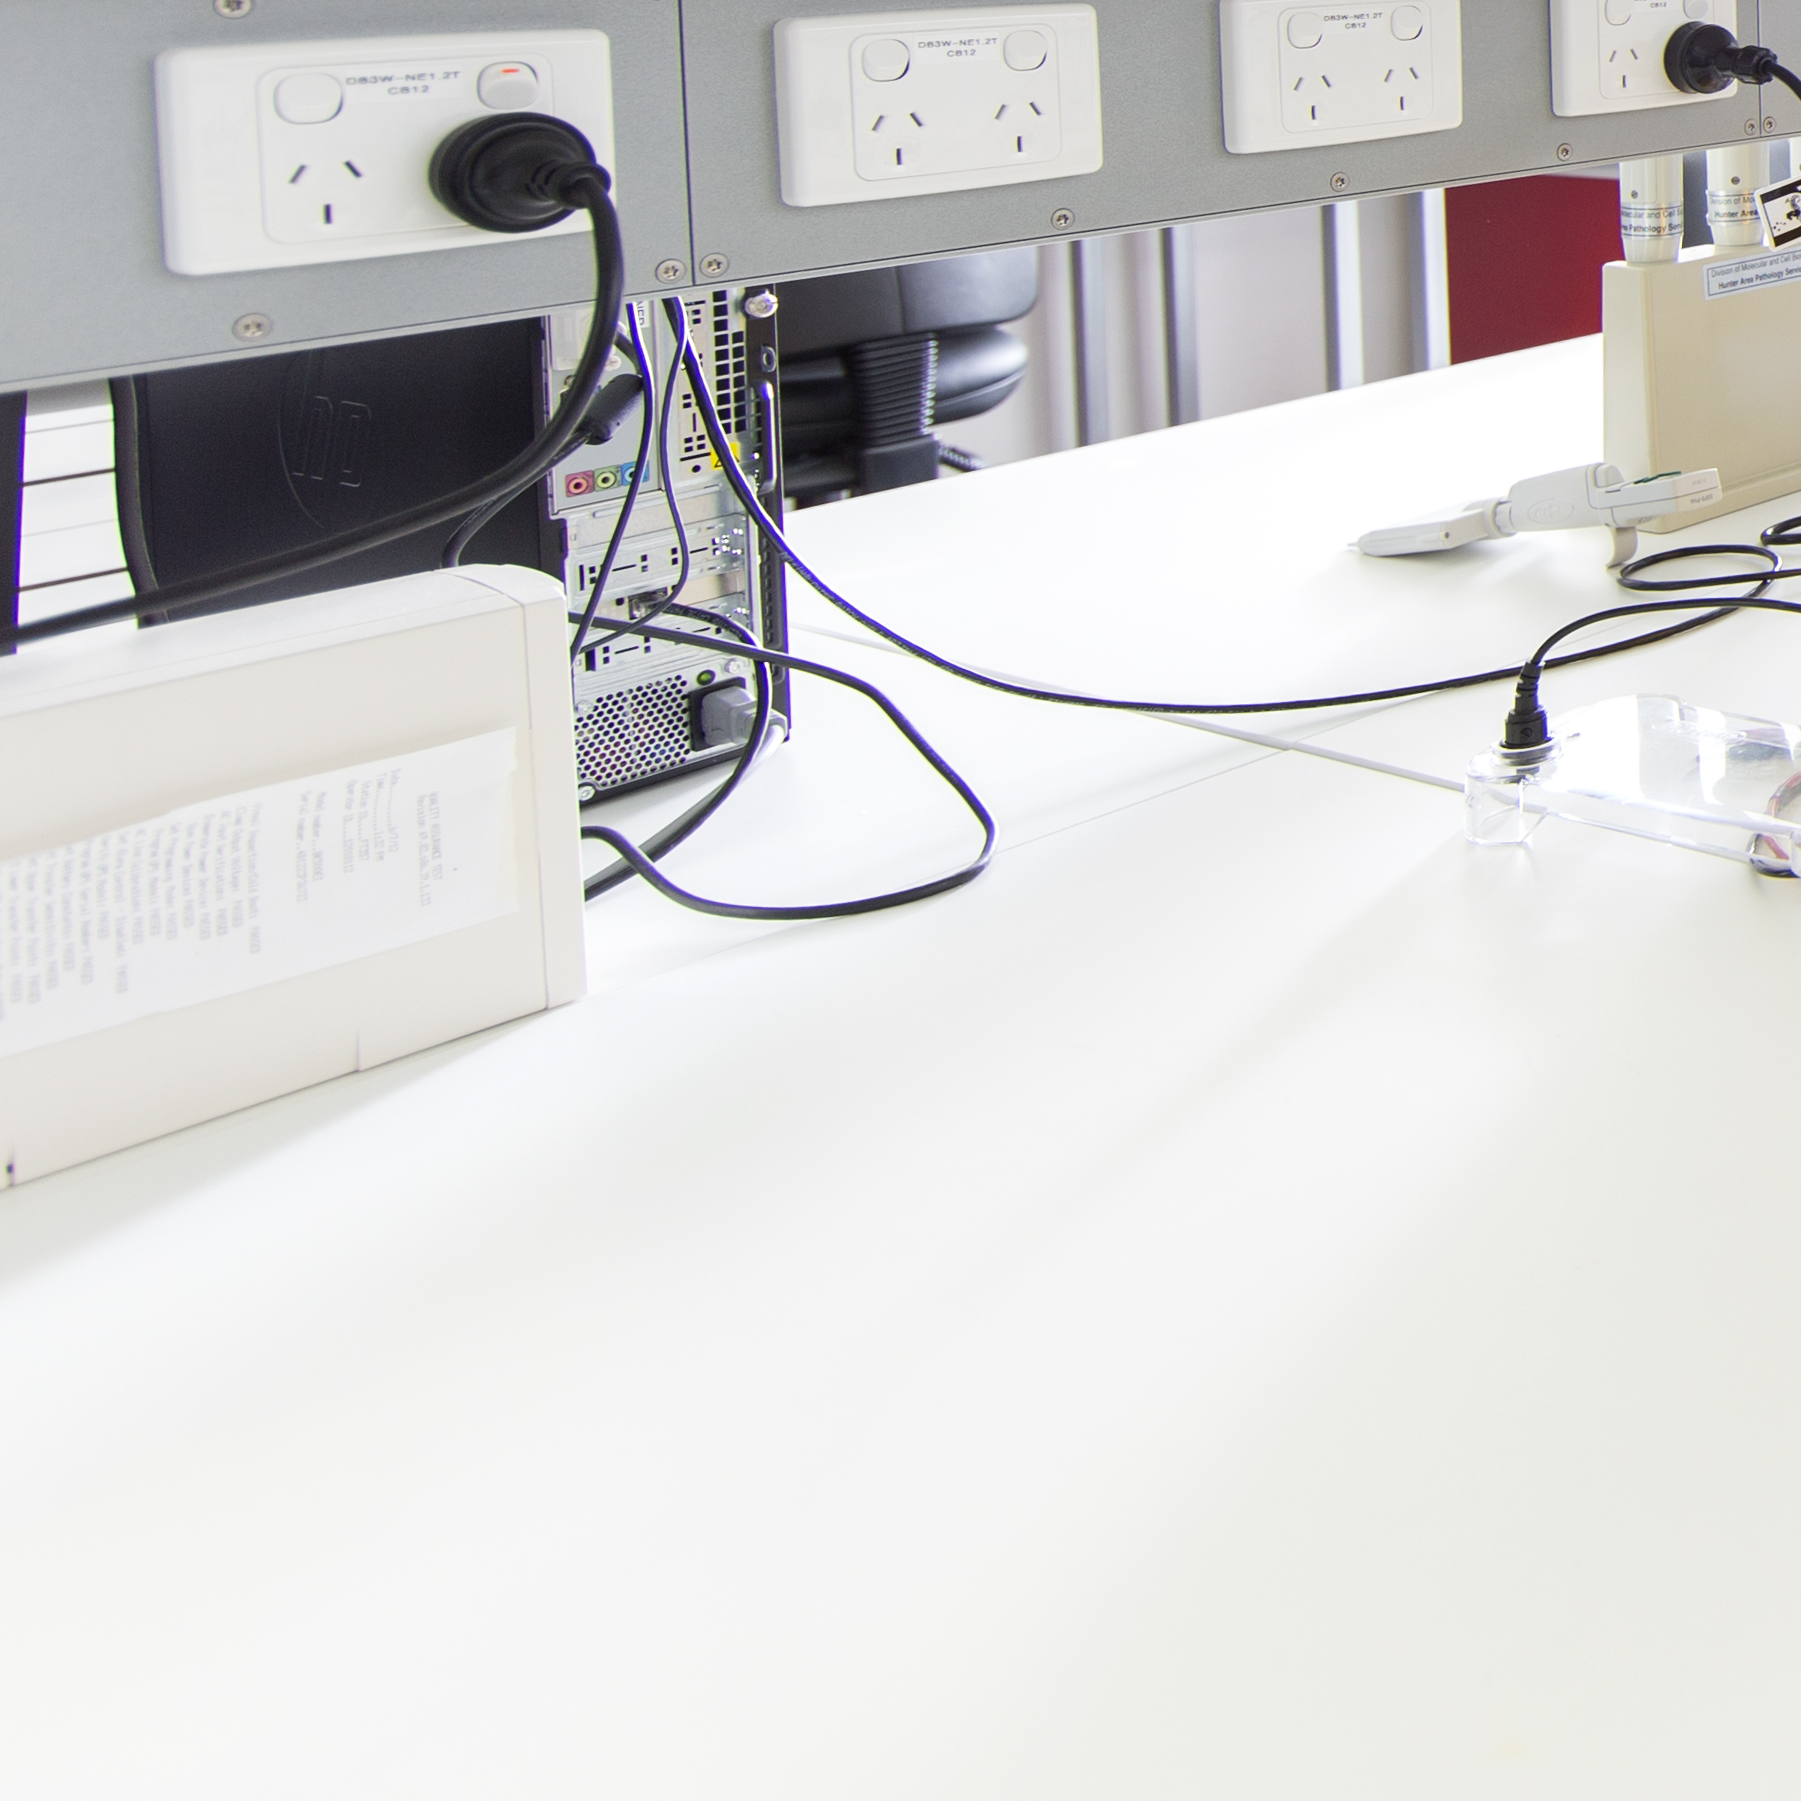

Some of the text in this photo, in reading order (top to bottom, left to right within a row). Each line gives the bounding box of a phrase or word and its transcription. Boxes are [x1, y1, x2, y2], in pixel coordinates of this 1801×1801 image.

[946, 48, 976, 57] CB12
[1718, 279, 1738, 290] Hunter
[1740, 276, 1754, 286] Area
[1755, 271, 1784, 283] Pathology
